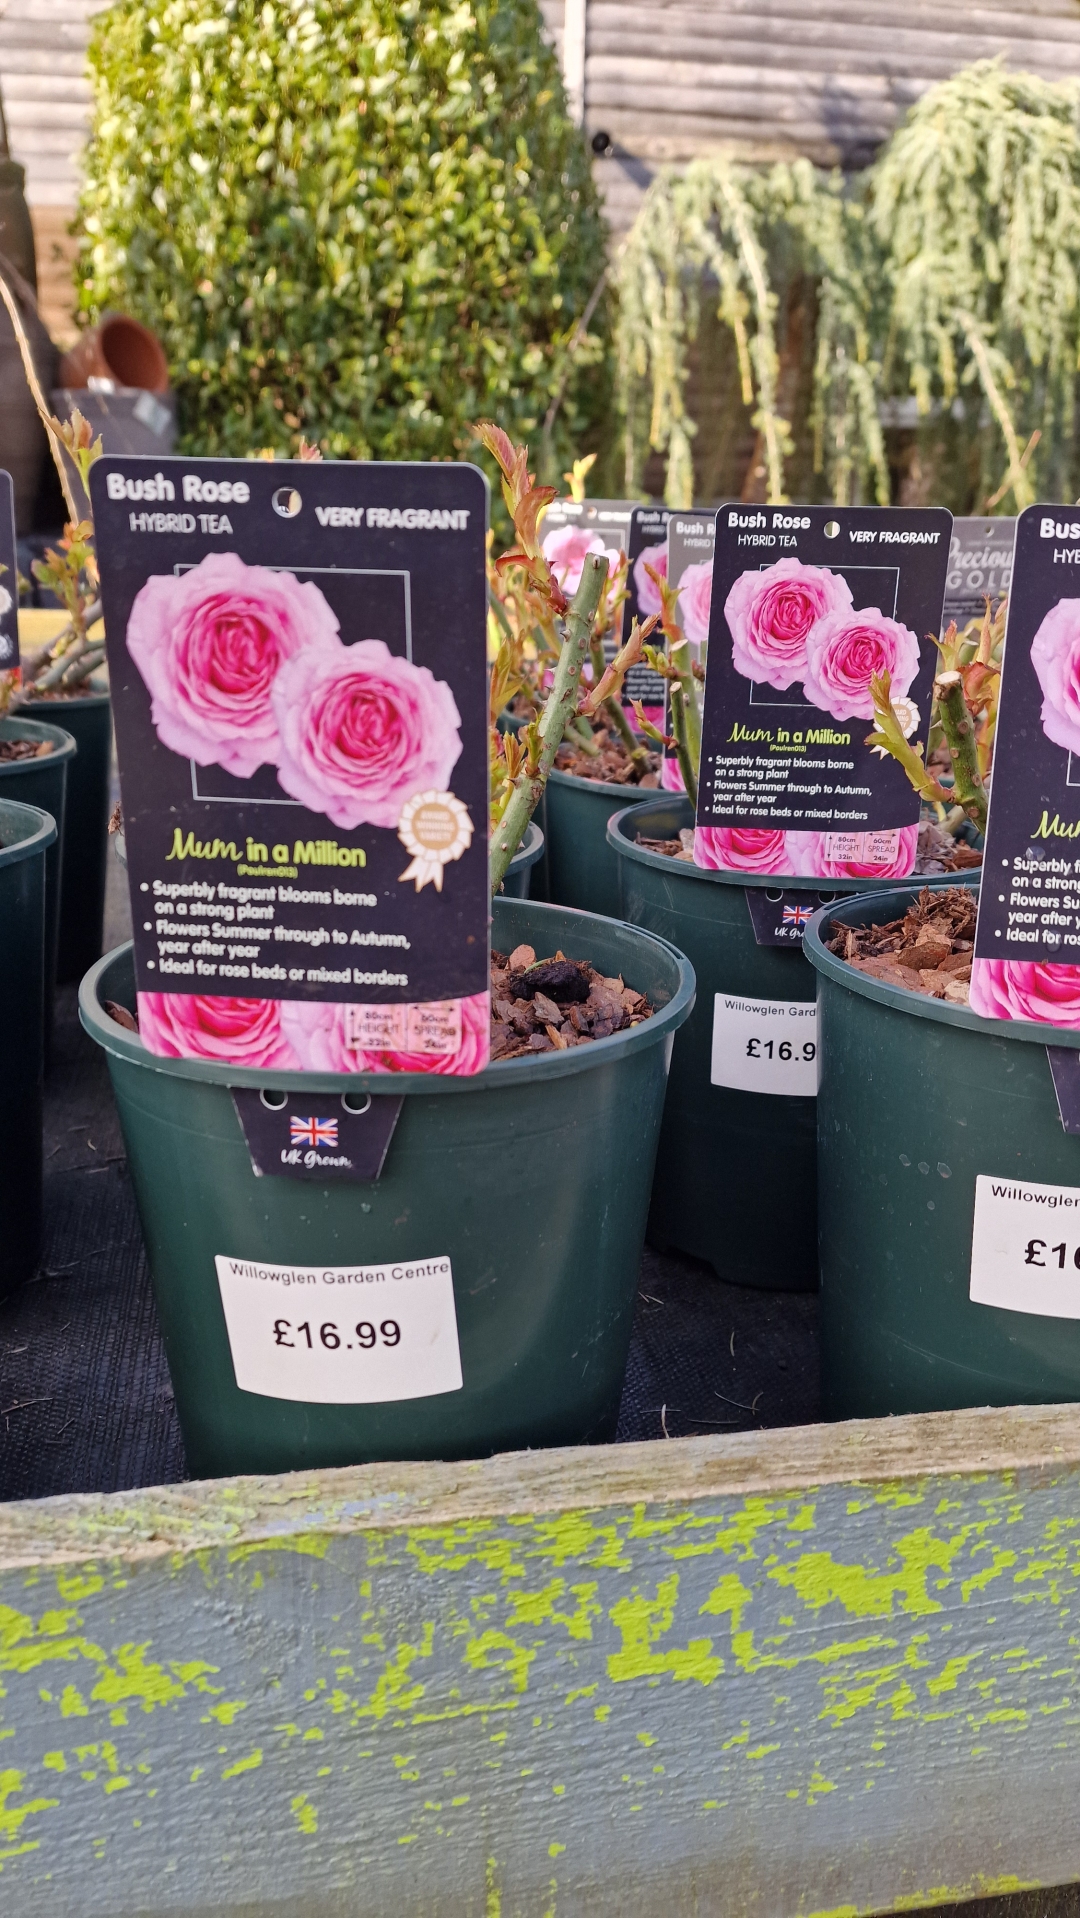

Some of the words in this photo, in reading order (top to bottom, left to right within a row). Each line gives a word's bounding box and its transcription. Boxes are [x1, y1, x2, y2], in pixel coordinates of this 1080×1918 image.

[106, 472, 175, 501] Bush
[182, 475, 250, 503] Rose
[129, 512, 196, 533] HYBRID
[197, 514, 234, 535] TEA
[315, 506, 364, 528] VERY
[366, 508, 471, 530] FRAGRANT
[728, 511, 766, 529] Bush
[772, 513, 811, 530] Rose
[676, 521, 704, 535] Bush
[684, 538, 711, 548] HYBRID
[737, 534, 775, 546] HYBRID
[779, 535, 798, 547] TEA
[849, 530, 877, 543] VERY
[879, 532, 940, 545] FRAGRANT
[726, 722, 774, 743] Mum
[777, 728, 790, 743] in
[793, 732, 803, 744] a
[805, 728, 851, 745] Million
[715, 755, 754, 768] Superbly
[755, 756, 792, 769] fragrant
[793, 757, 826, 769] blooms
[827, 759, 854, 770] borne
[715, 769, 727, 777] on
[728, 769, 735, 777] a
[736, 768, 764, 780] strong
[765, 767, 789, 780] plant
[714, 780, 747, 791] Flowers
[749, 781, 786, 792] Summer
[787, 782, 822, 795] through
[823, 784, 833, 794] to
[834, 784, 872, 797] Autumn,
[713, 793, 733, 803] year
[734, 792, 755, 802] after
[757, 794, 777, 804] year
[712, 804, 733, 814] Ideal
[735, 805, 748, 815] for
[750, 807, 769, 816] rose
[770, 806, 792, 817] beds
[794, 809, 803, 817] or
[805, 808, 832, 819] mixed
[834, 809, 868, 820] borders
[165, 828, 243, 861] Mum
[246, 837, 268, 862] in
[272, 844, 289, 863] a
[293, 840, 366, 867] Million
[832, 844, 860, 852] HEIGHT
[867, 845, 896, 853] SPREAD
[1013, 857, 1072, 876] Superbly
[1012, 876, 1029, 888] on
[1032, 876, 1042, 889] a
[152, 879, 215, 901] Superbly
[218, 882, 276, 904] fragrant
[279, 886, 332, 905] blooms
[334, 888, 377, 907] borne
[1010, 892, 1060, 909] Flowers
[154, 901, 174, 915] on
[176, 903, 188, 915] a
[189, 901, 235, 921] strong
[237, 903, 274, 920] plant
[1008, 911, 1038, 925] year
[1041, 910, 1073, 926] after
[156, 919, 210, 937] Flowers
[212, 922, 273, 941] Summer
[273, 925, 330, 946] through
[332, 929, 348, 944] to
[350, 930, 411, 950] Autumn,
[774, 927, 788, 937] UK
[1006, 927, 1039, 943] Ideal
[1042, 929, 1061, 944] for
[157, 941, 190, 956] year
[191, 940, 226, 956] after
[228, 943, 260, 960] year
[159, 958, 194, 974] Ideal
[196, 959, 217, 975] for
[219, 965, 250, 978] rose
[251, 962, 287, 981] beds
[289, 967, 306, 981] or
[307, 967, 352, 984] mixed
[353, 968, 409, 986] borders
[725, 1000, 785, 1016] Willowglen
[281, 1149, 302, 1165] UK
[229, 1262, 317, 1286] Willowglen
[322, 1271, 386, 1285] Garden
[391, 1262, 449, 1280] Centre
[272, 1319, 401, 1350] £16.99
